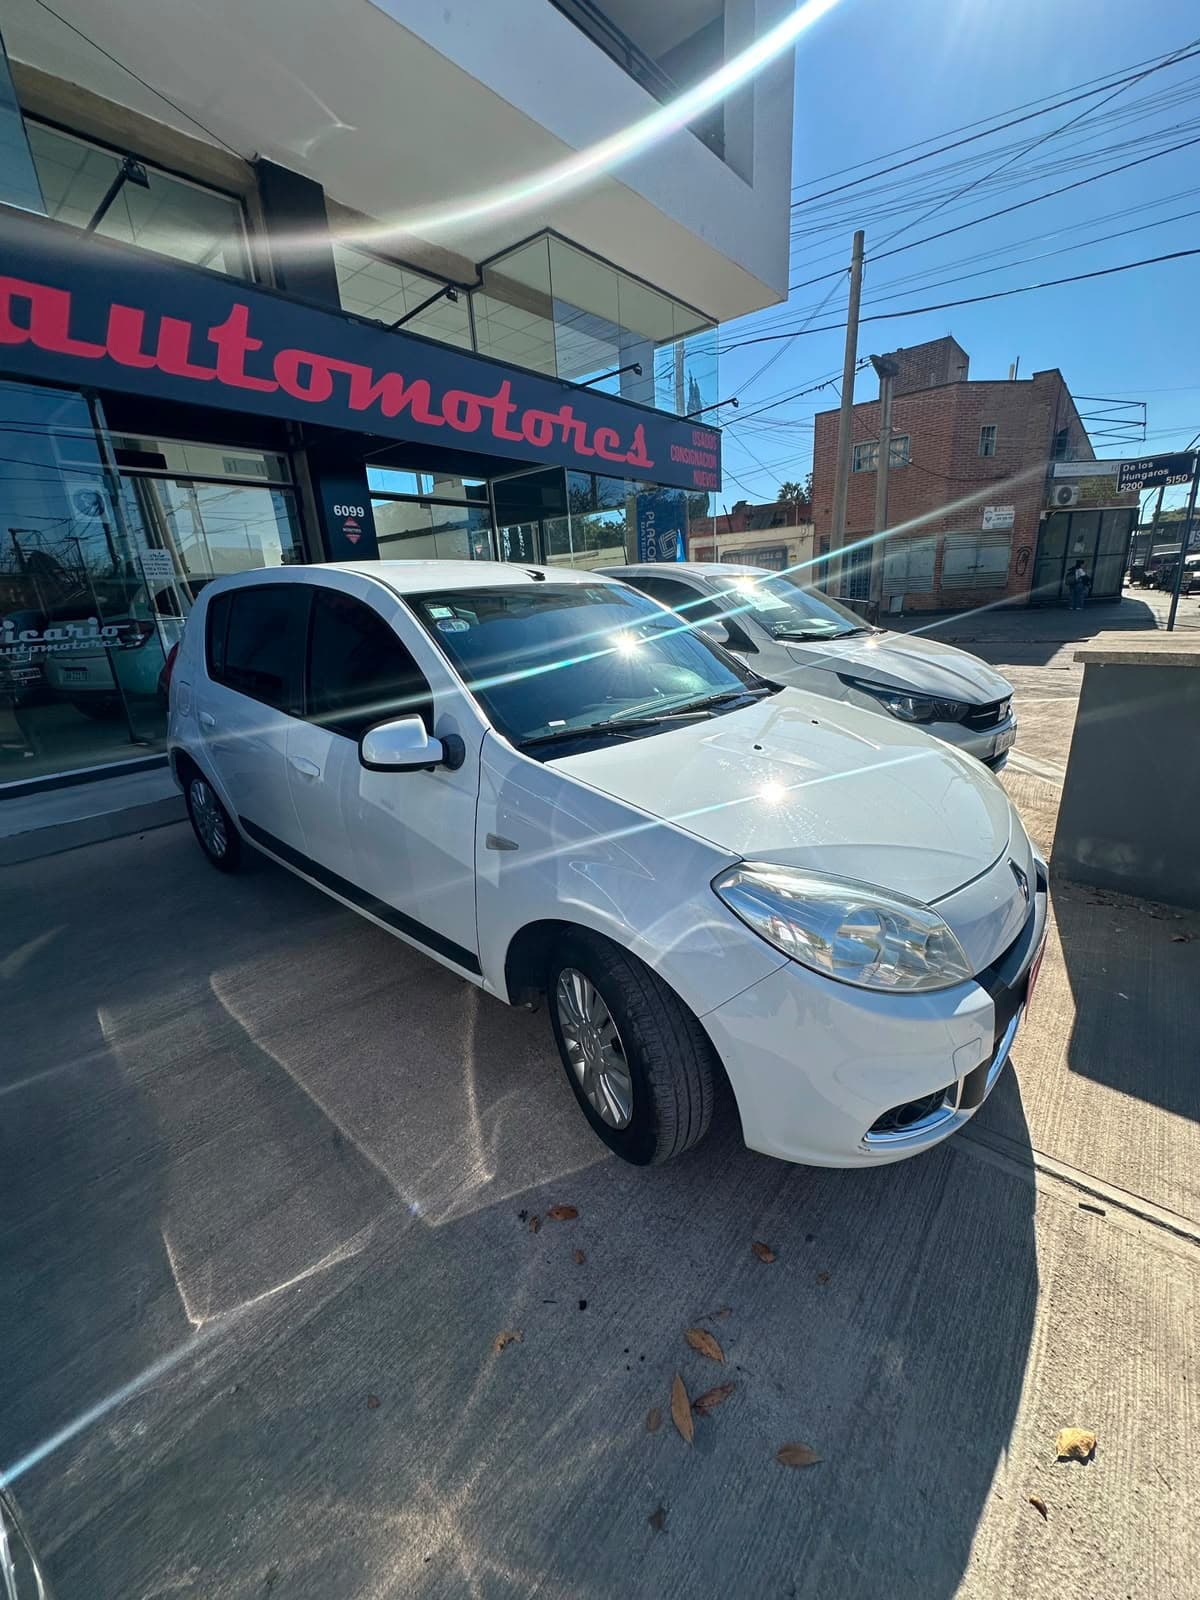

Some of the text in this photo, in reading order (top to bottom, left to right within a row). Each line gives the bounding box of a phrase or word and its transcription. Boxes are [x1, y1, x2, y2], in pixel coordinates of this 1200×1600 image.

[691, 430, 717, 450] USADOS
[670, 443, 718, 469] CONSIGNACION
[1122, 461, 1153, 472] De los
[1122, 468, 1169, 481] Hungaros
[1166, 473, 1188, 485] 5150
[1120, 481, 1144, 491] 5200
[333, 504, 365, 518] 6099
[0, 616, 131, 645] icario
[0, 637, 125, 656] utomotores
